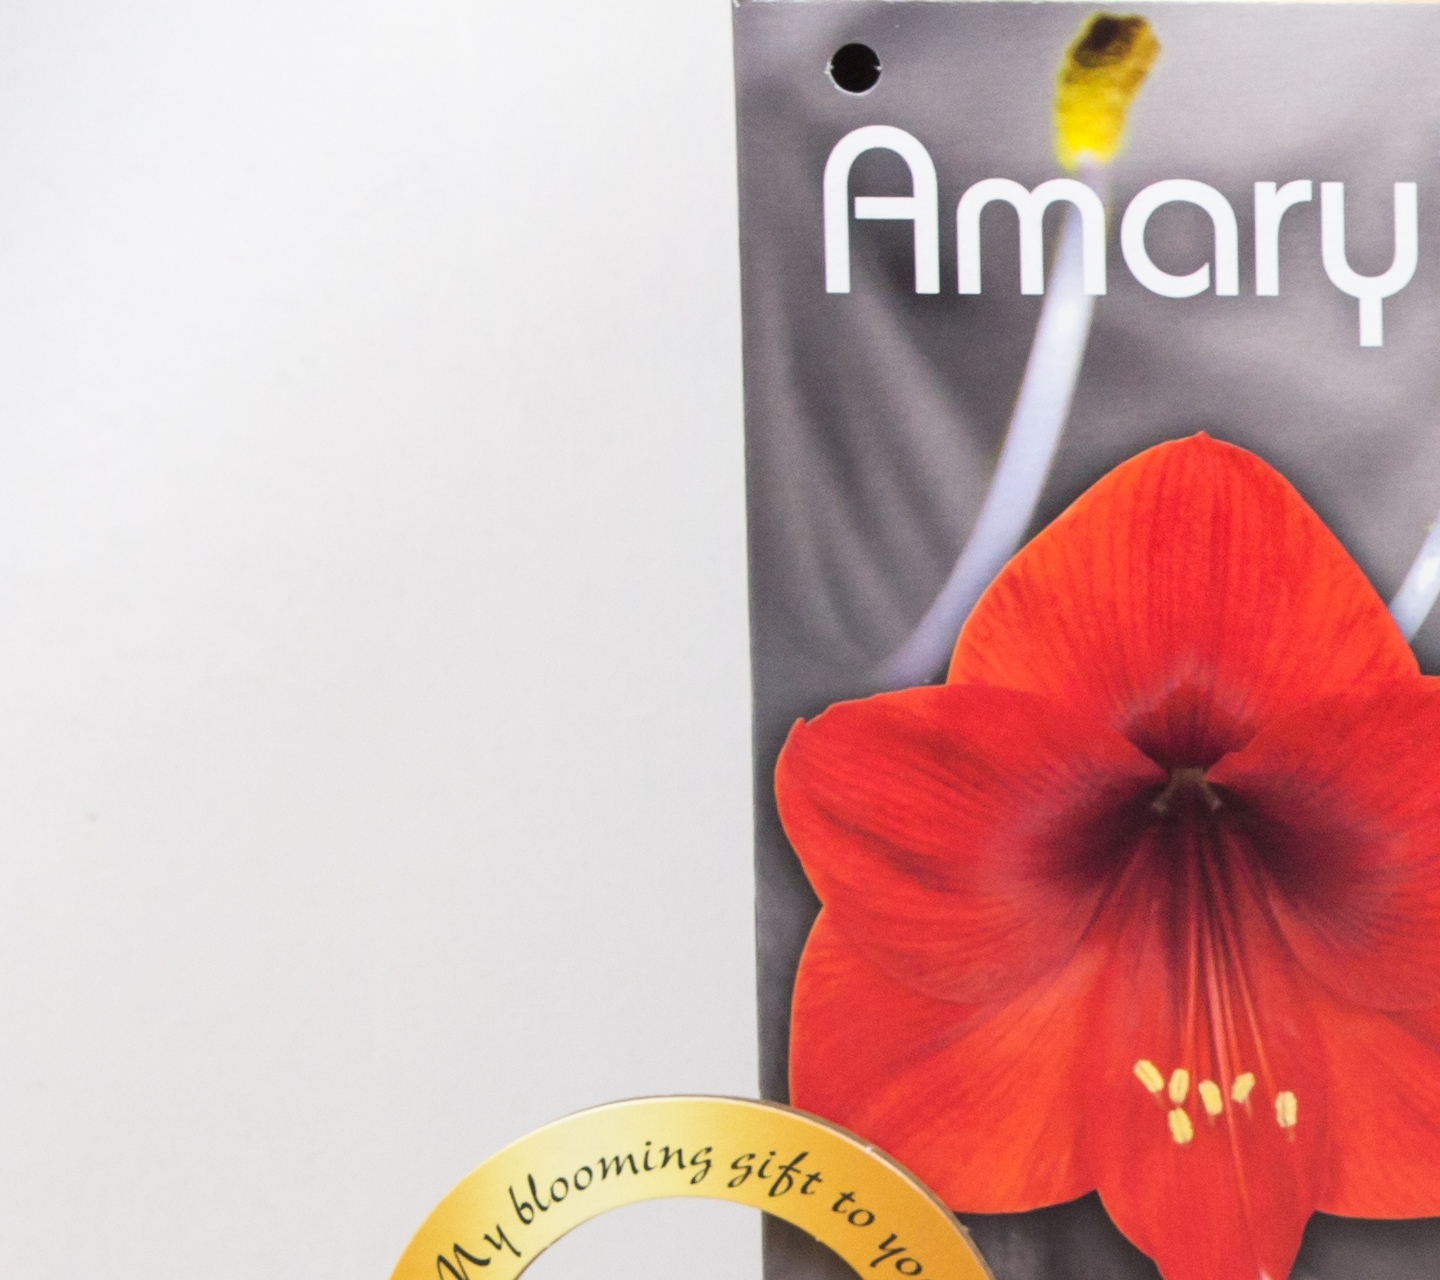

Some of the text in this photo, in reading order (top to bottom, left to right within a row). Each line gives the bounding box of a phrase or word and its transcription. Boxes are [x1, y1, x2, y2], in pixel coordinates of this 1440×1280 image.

[507, 1141, 713, 1227] blooming
[729, 1152, 824, 1197] gift
[830, 1190, 876, 1227] to
